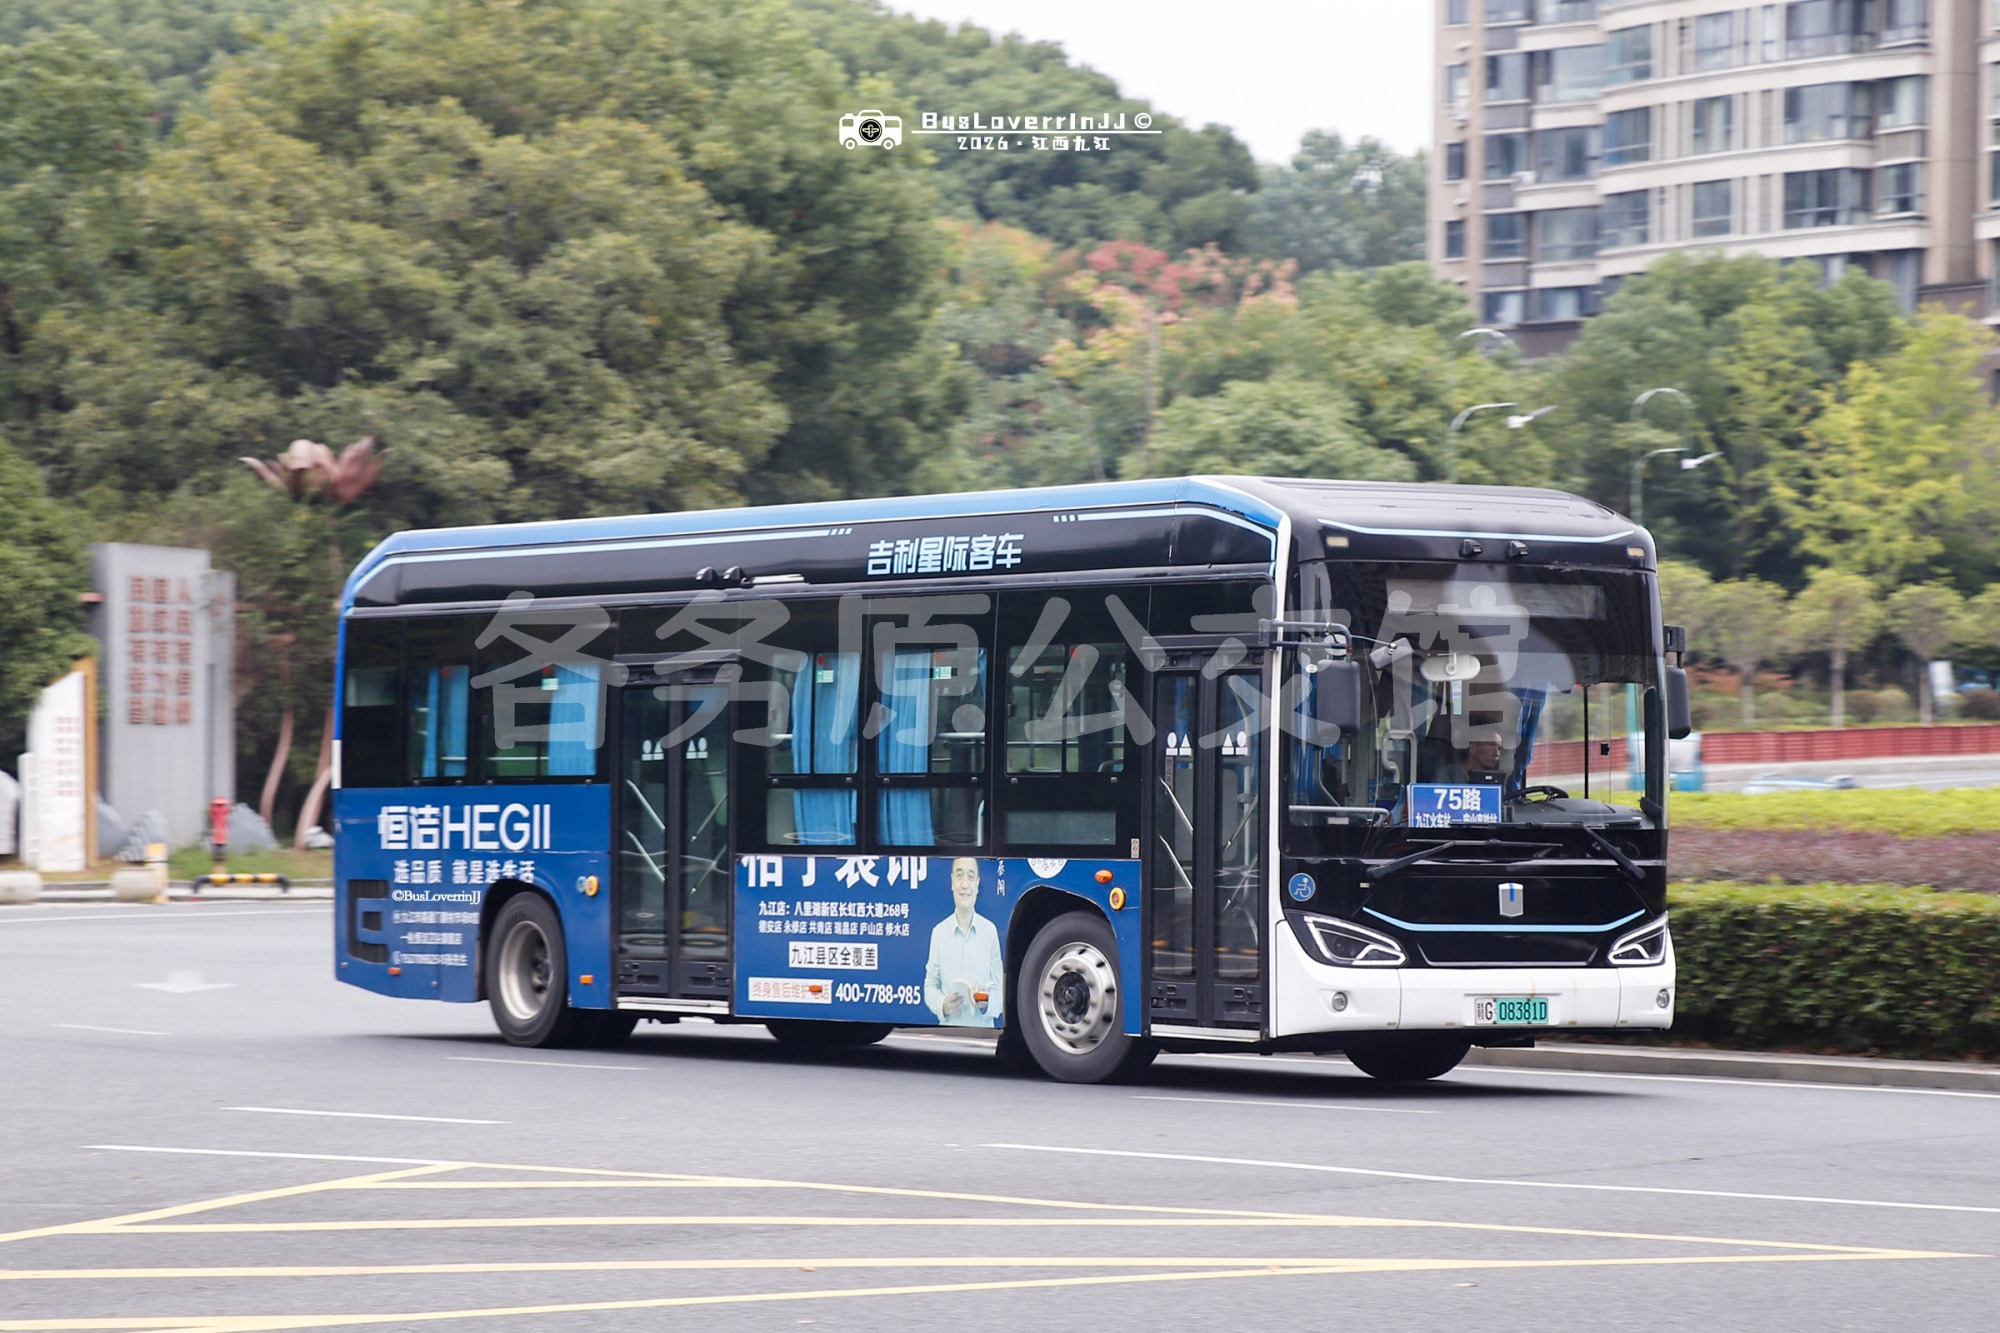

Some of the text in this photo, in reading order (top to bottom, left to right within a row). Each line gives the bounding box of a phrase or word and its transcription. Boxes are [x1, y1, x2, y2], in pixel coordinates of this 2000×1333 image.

[867, 533, 1024, 576] 吉利星际客车
[1434, 788, 1481, 811] 75路
[393, 859, 442, 884] 选品质
[791, 945, 876, 967] 九江县区全覆盖
[835, 983, 921, 1005] 400-7788-985
